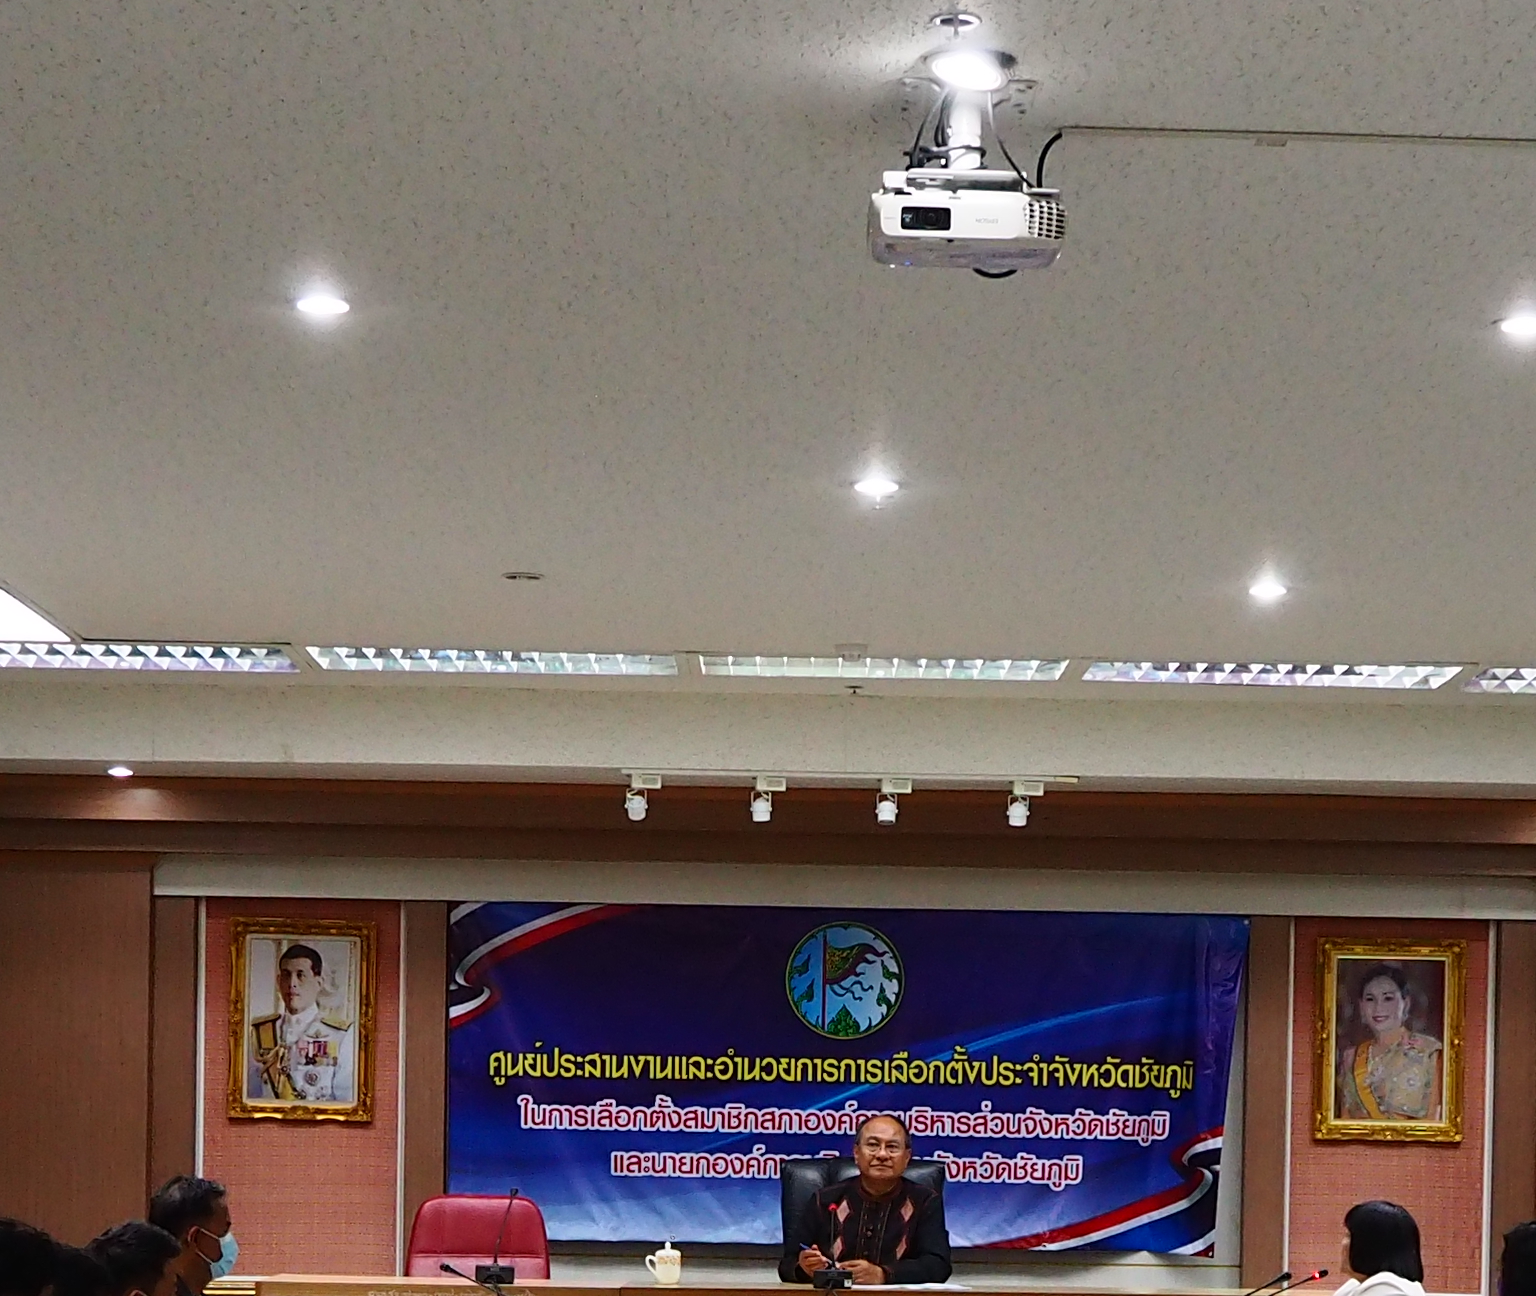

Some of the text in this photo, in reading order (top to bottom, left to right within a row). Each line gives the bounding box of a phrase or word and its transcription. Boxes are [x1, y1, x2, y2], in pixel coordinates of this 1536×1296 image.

[489, 1042, 1194, 1098] ศูนย์ประสานงานและอำนวยการการเลือกตั้งประจำจังหวัดชัยภูมิ
